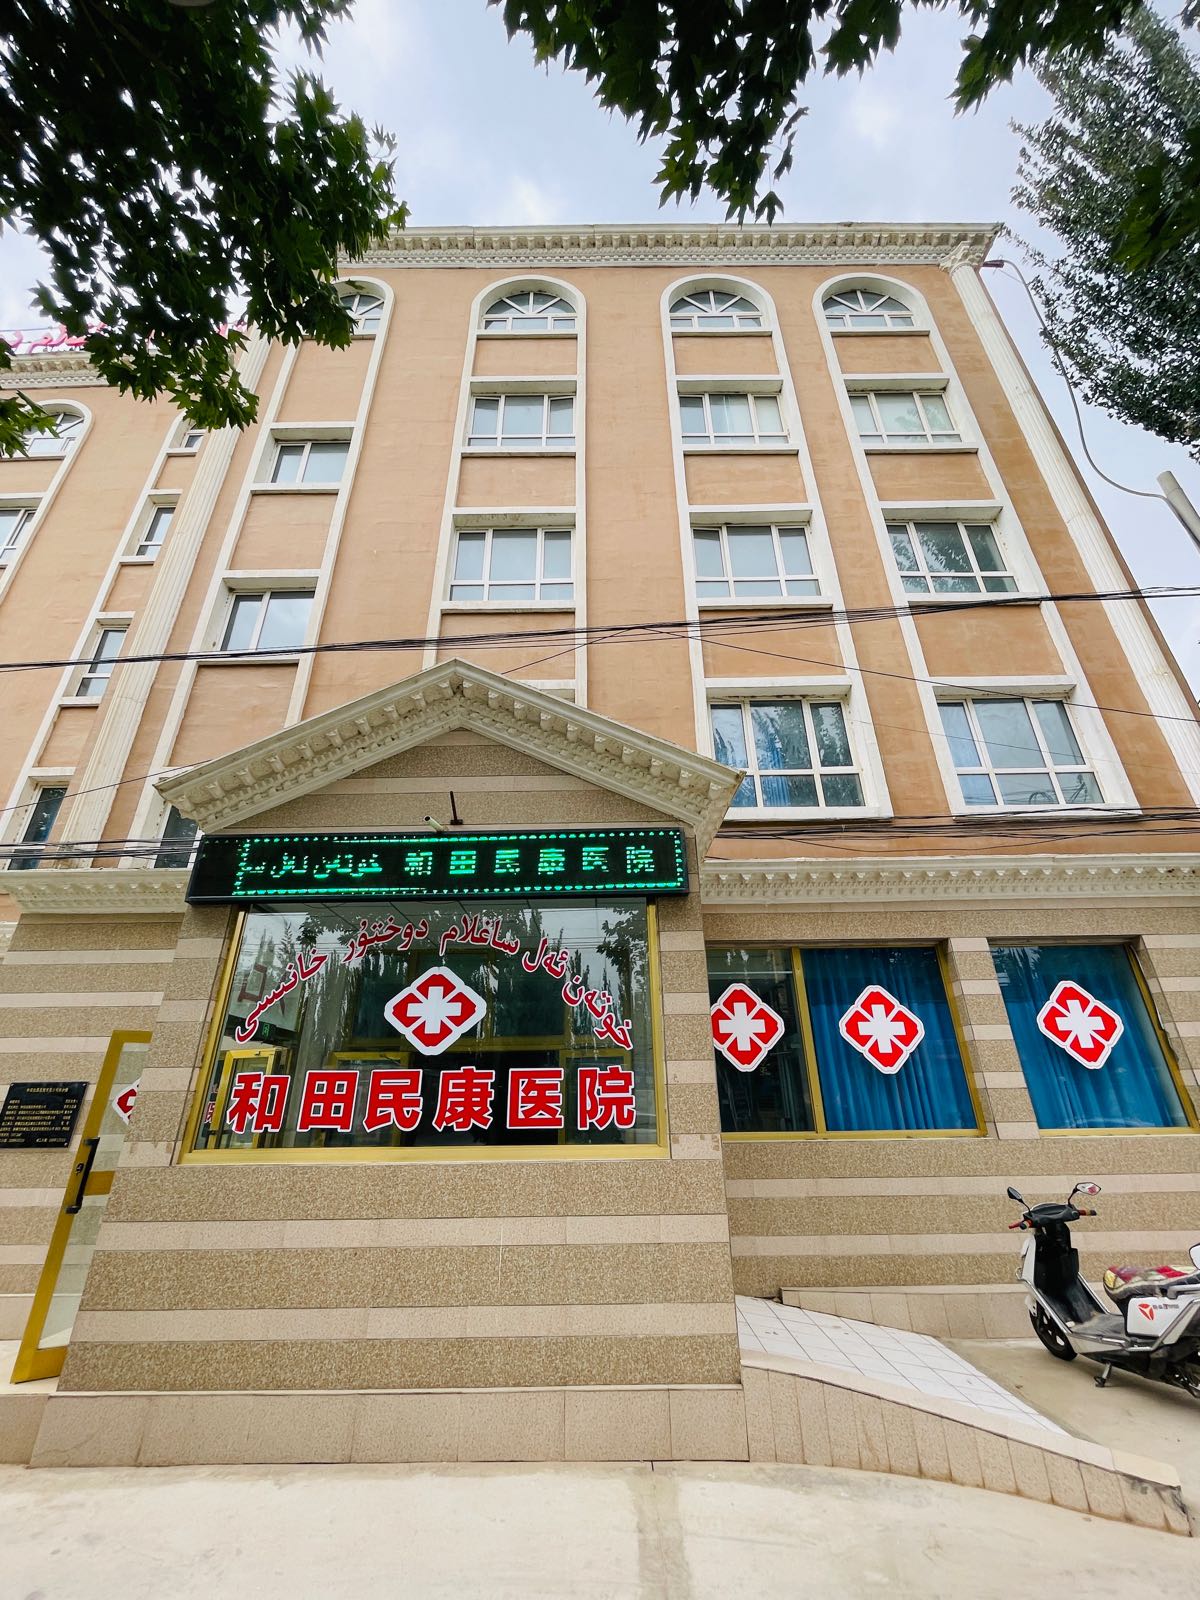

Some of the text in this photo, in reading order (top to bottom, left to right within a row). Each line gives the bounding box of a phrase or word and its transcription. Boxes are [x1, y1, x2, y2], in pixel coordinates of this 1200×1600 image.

[235, 914, 633, 1050] خوتەن ئەل ساغلام دوختۇر خانىسى
[226, 1066, 637, 1134] 和田民康医院
